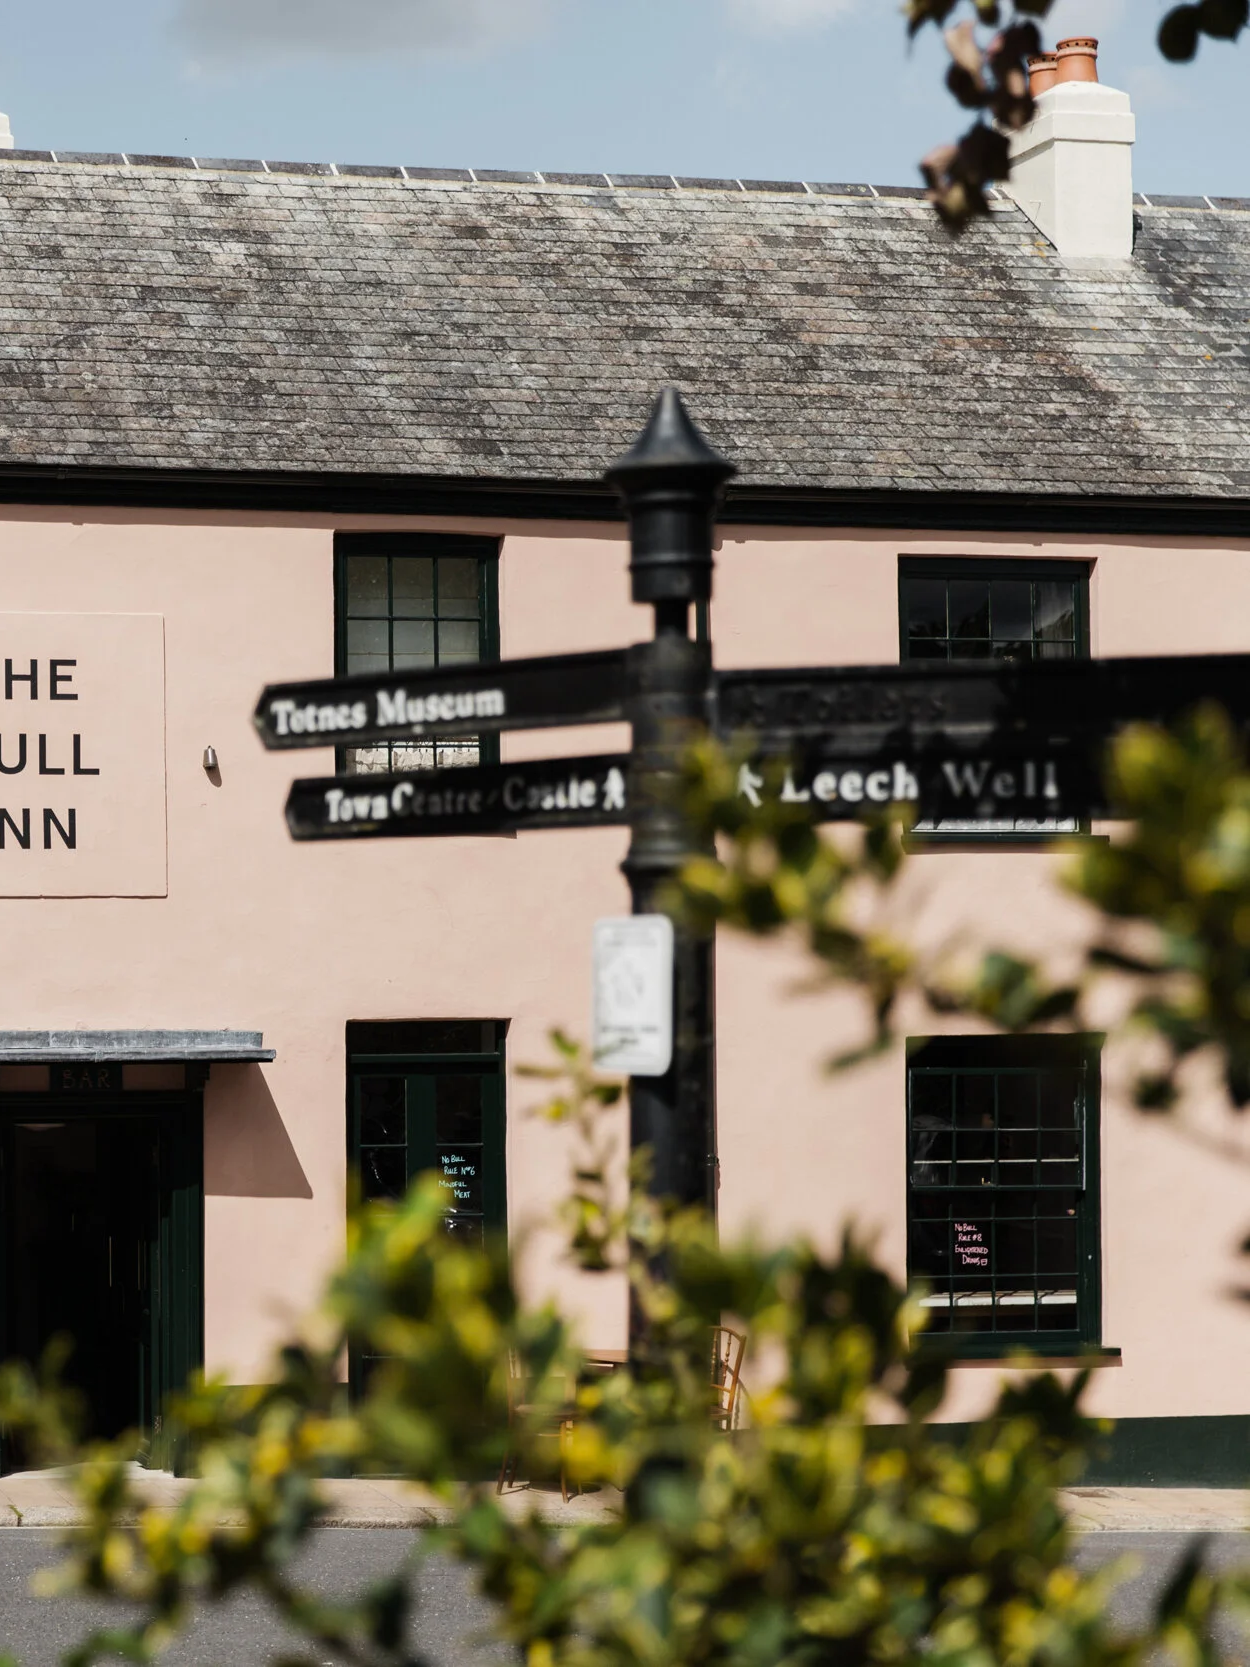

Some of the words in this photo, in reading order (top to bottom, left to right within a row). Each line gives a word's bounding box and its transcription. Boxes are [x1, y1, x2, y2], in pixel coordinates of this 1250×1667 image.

[269, 700, 367, 735] Totnes
[375, 688, 505, 727] Museum
[324, 788, 389, 823] Town
[390, 781, 482, 817] Centre
[502, 774, 597, 811] Castle
[780, 760, 919, 802] Leech
[941, 760, 1059, 800] Well
[61, 1068, 111, 1089] BAR
